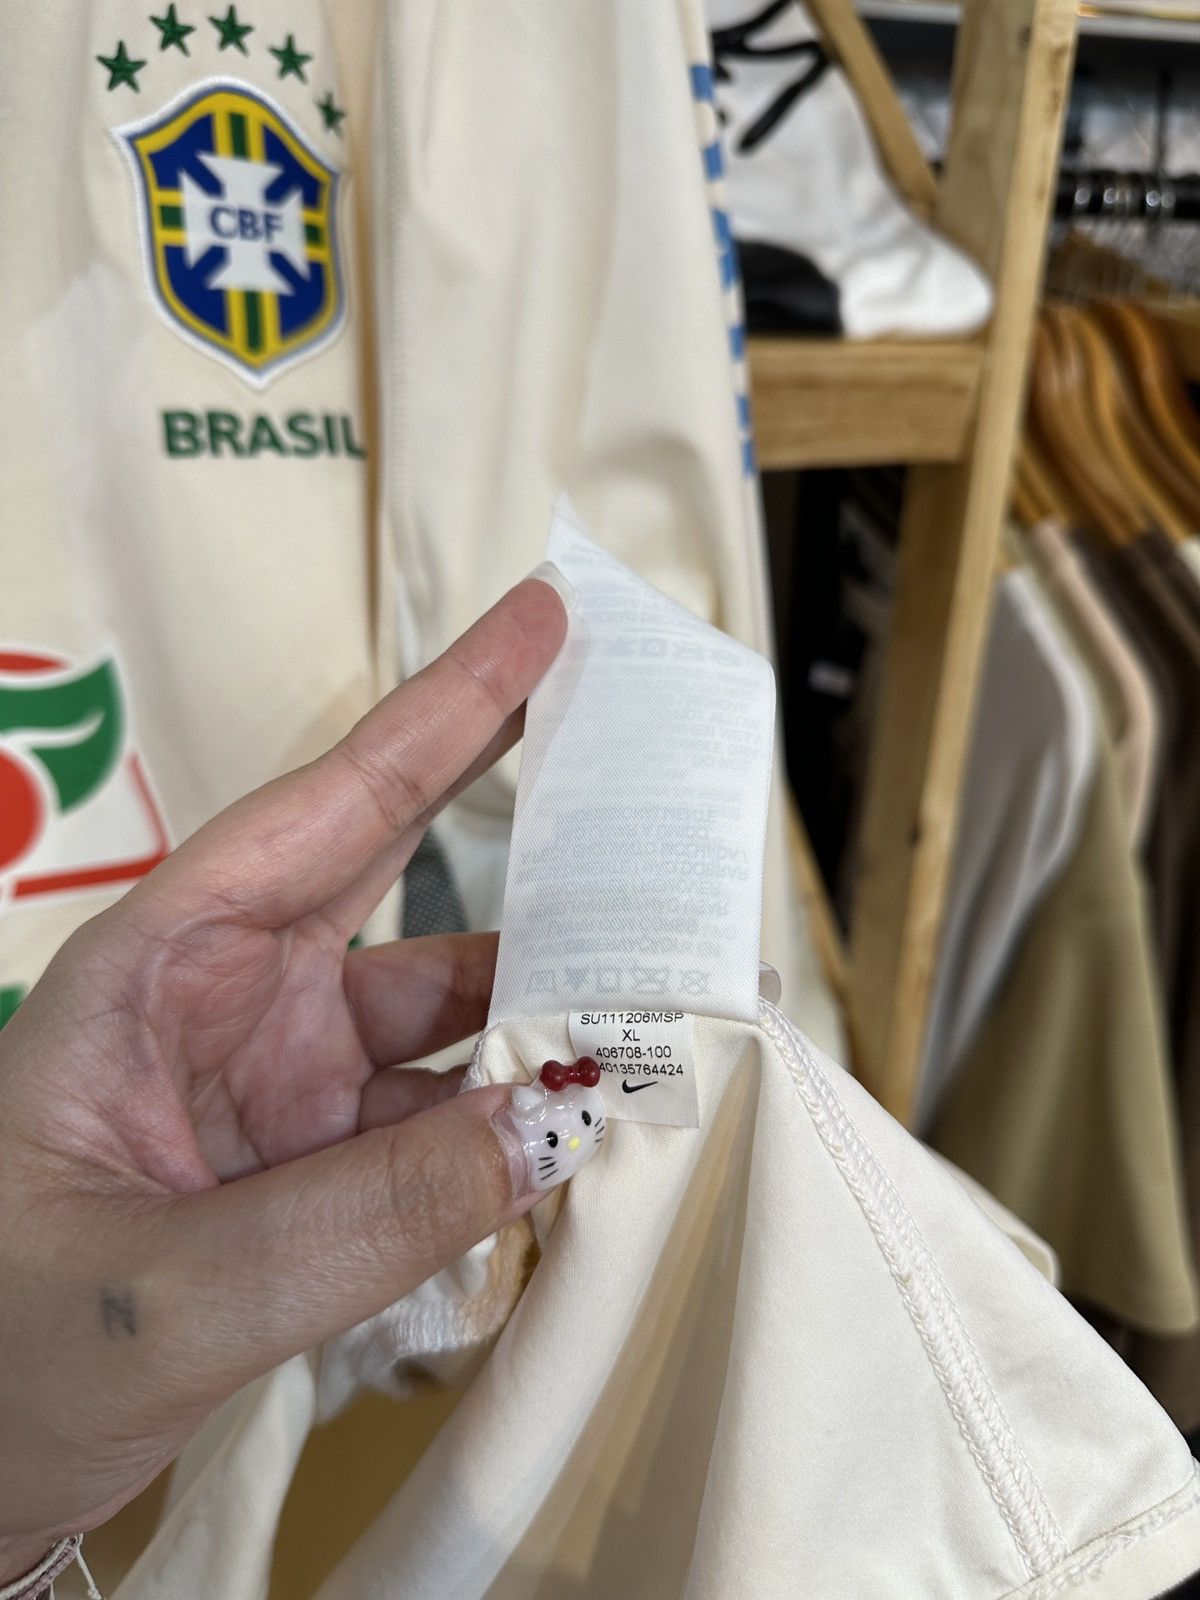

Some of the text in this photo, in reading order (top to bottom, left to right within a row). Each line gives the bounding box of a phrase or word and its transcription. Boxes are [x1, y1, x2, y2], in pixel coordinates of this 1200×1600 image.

[210, 206, 282, 243] CBF
[162, 410, 367, 458] BRASIL
[580, 1012, 684, 1025] SU111206MSP
[622, 1029, 640, 1041] XL
[596, 1046, 672, 1058] 406708-100
[599, 1062, 684, 1076] 40135764424
